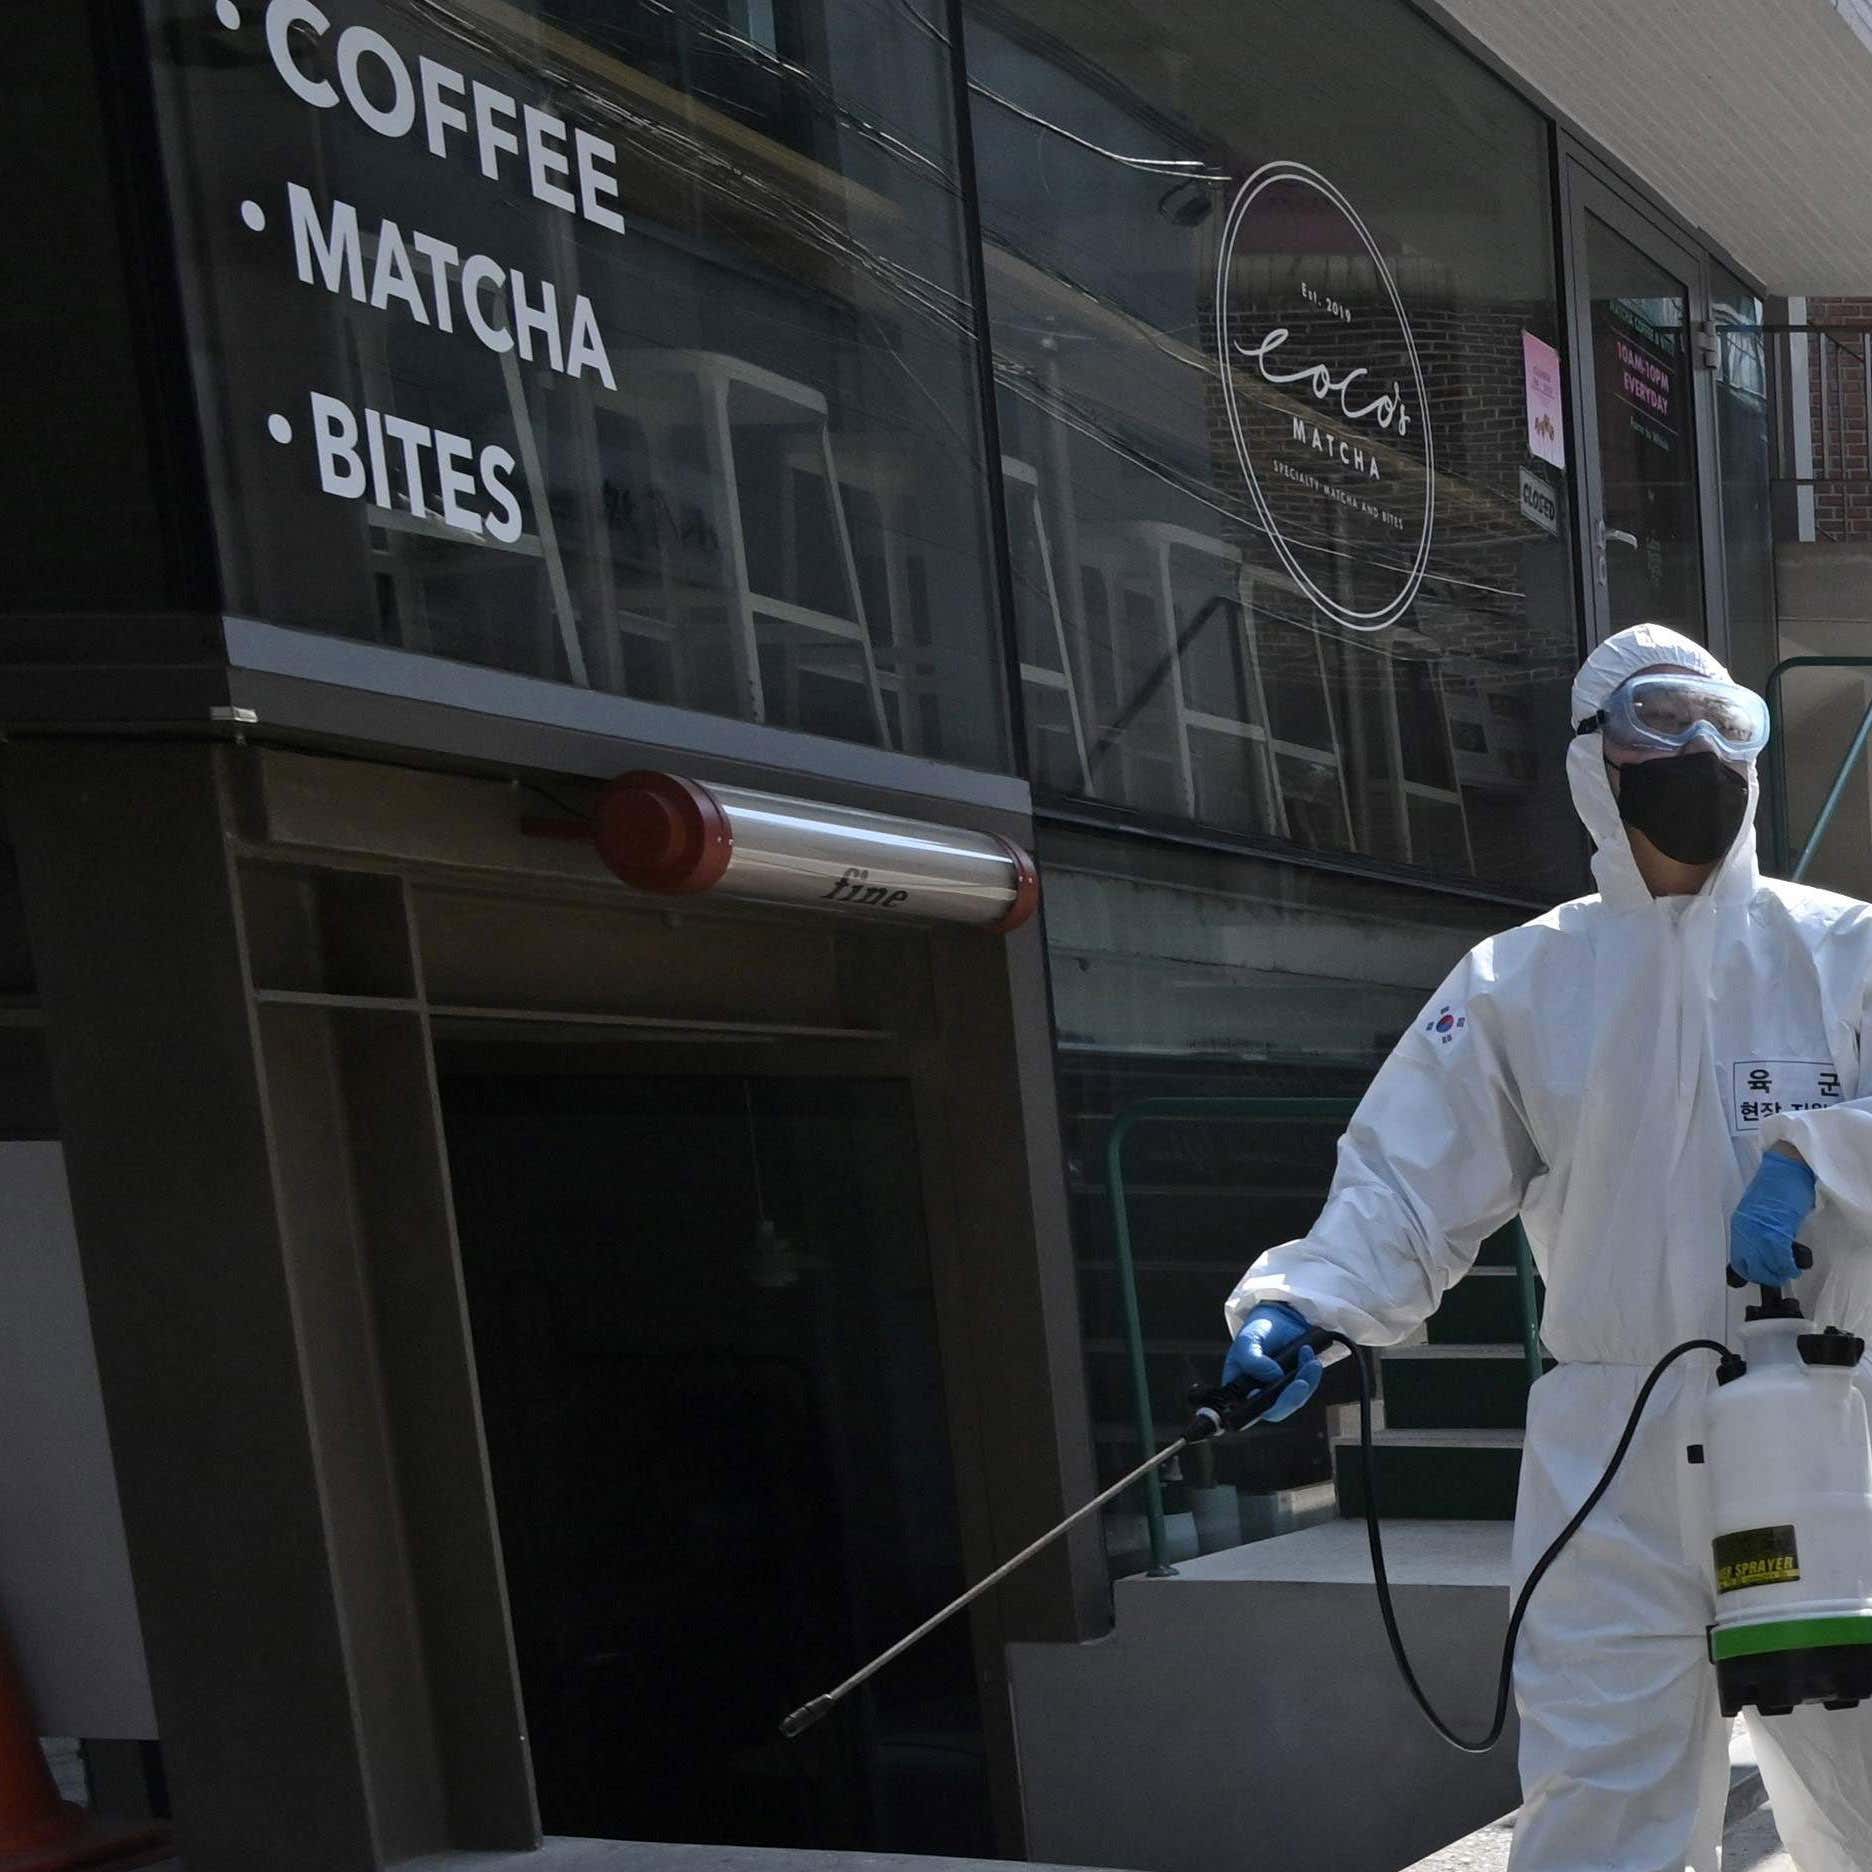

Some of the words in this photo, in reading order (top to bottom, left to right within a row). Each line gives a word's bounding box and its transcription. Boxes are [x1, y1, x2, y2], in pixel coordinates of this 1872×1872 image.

[266, 0, 625, 234] COFFEE
[287, 181, 617, 391] MATCHA
[1326, 298, 1351, 323] 2019
[1624, 372, 1668, 416] EVERYDAY
[310, 392, 522, 544] BITES
[1293, 416, 1380, 480] MATCHA
[1273, 460, 1319, 491] SPECIALTY
[1324, 483, 1358, 508] MATCHA
[1362, 502, 1379, 518] AND
[1523, 483, 1555, 521] CLOSED
[1747, 1069, 1772, 1094] 육
[1818, 1072, 1841, 1097] 군
[1735, 1556, 1794, 1577] SPRAYER
